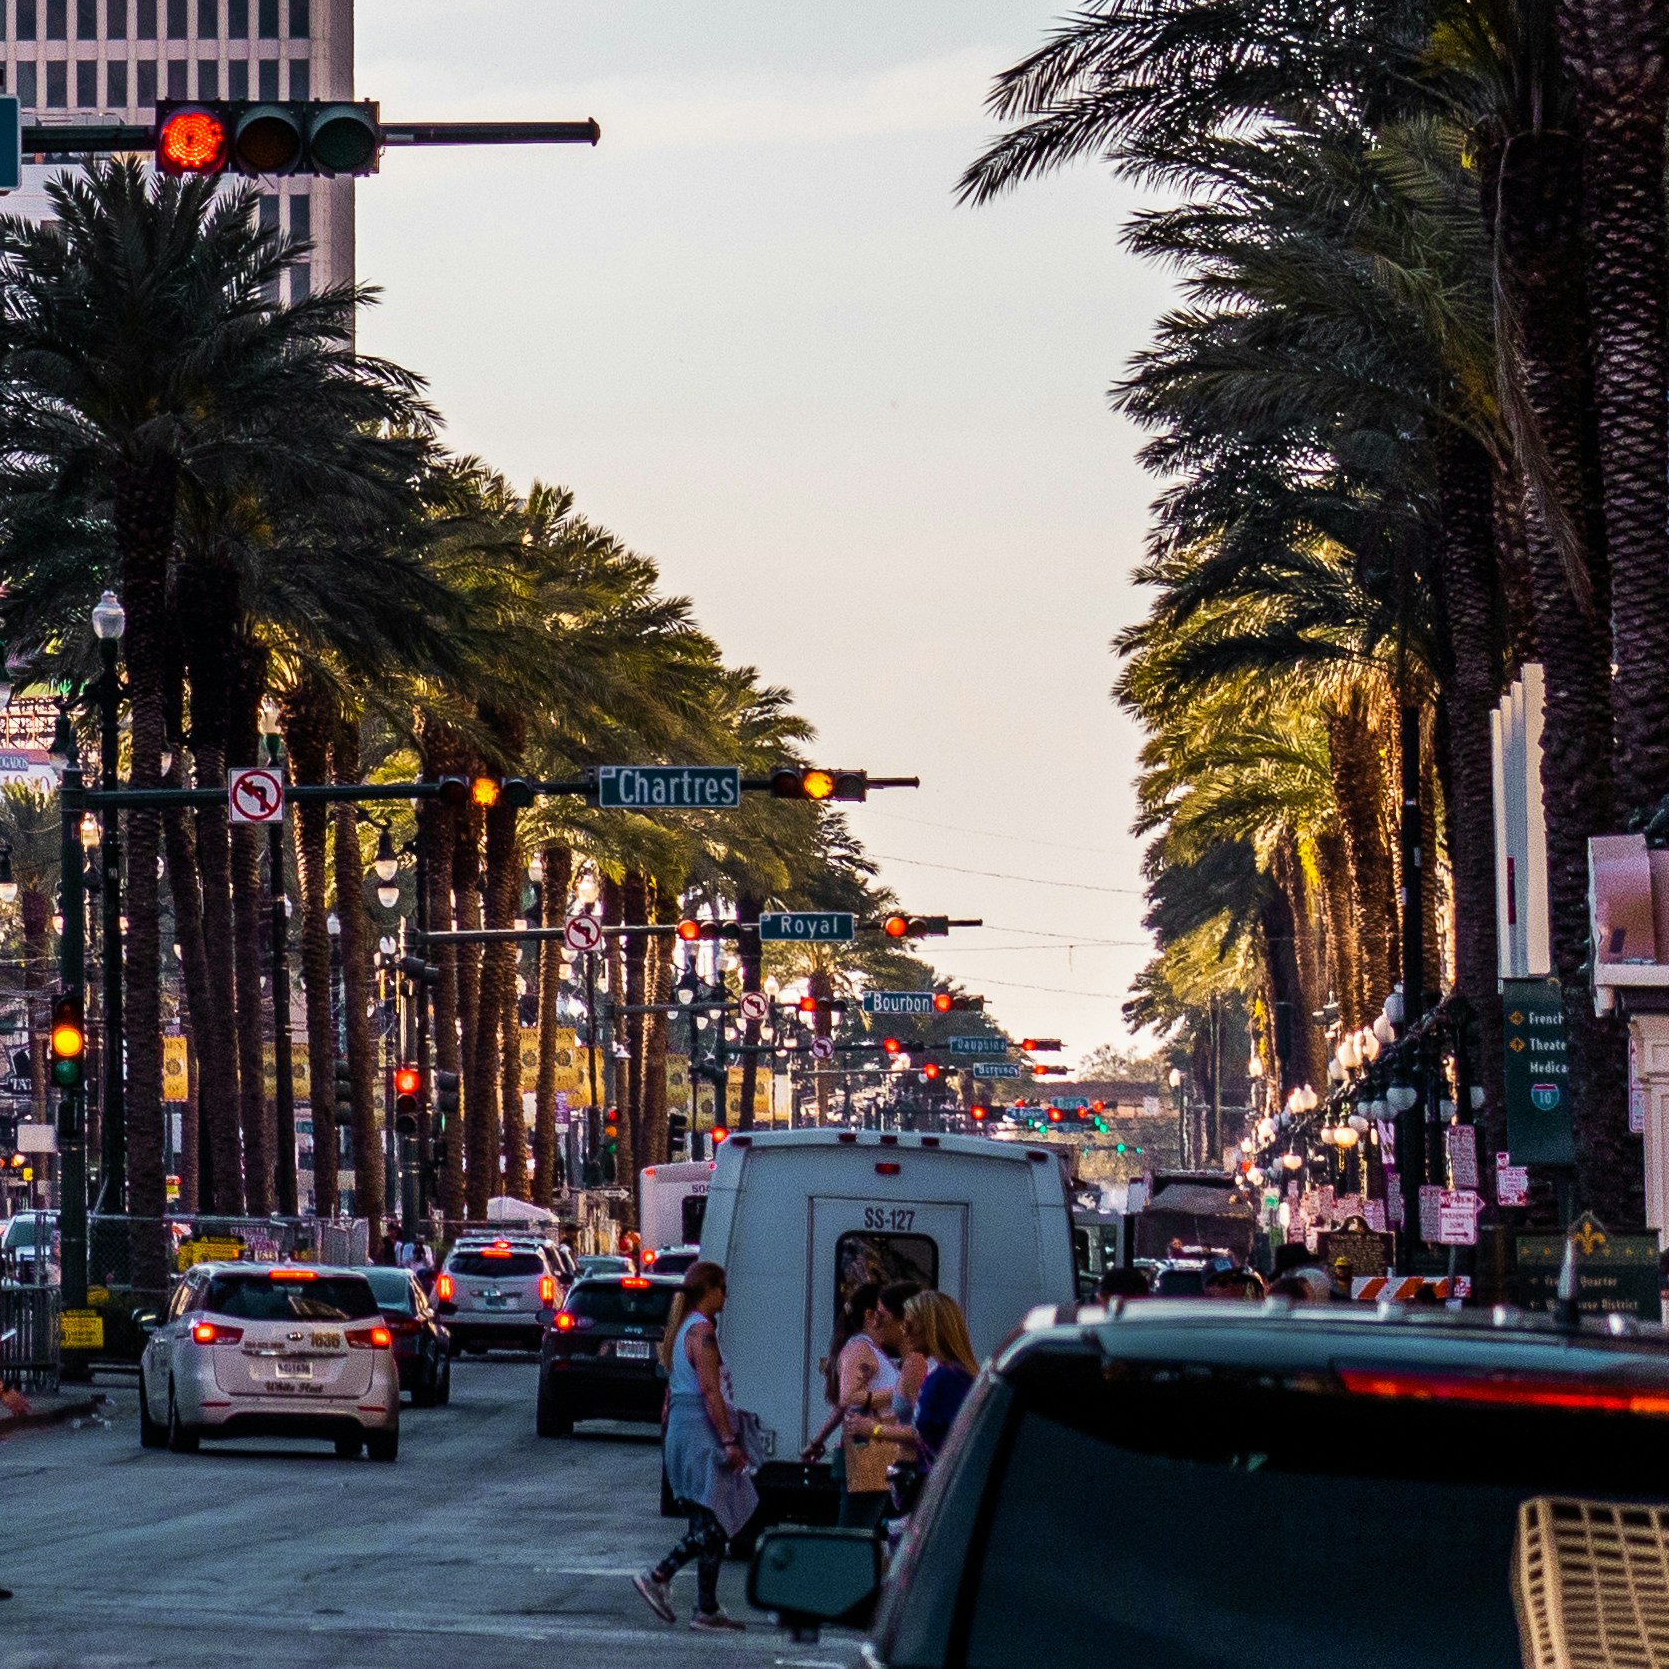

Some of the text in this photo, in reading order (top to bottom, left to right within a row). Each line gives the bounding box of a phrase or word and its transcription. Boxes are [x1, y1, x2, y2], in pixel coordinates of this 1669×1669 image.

[619, 769, 735, 804] Chartres
[781, 915, 838, 938] Royal
[873, 992, 930, 1012] Bourbon
[1529, 1037, 1567, 1051] Theate
[1530, 1061, 1569, 1074] Medica
[864, 1208, 915, 1231] SS-127
